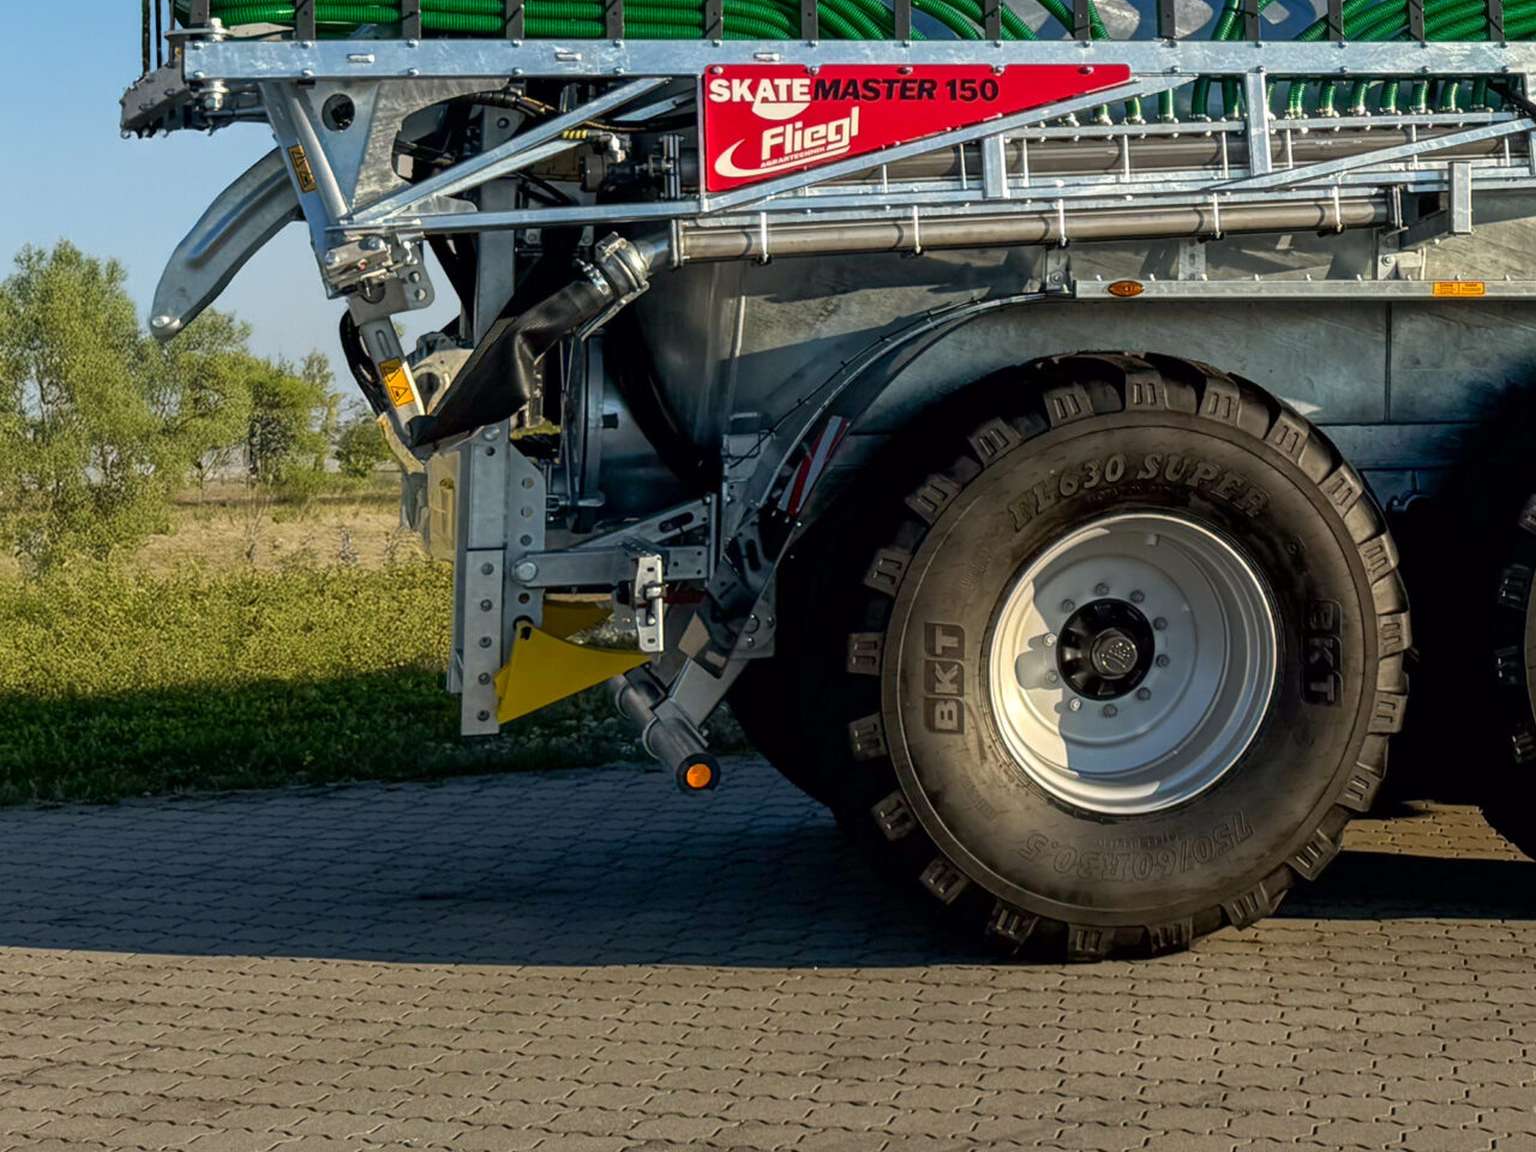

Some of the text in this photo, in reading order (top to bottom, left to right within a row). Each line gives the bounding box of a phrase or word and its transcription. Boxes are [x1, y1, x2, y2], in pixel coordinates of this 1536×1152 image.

[945, 77, 1000, 102] 150
[760, 105, 860, 161] Fliegl
[1136, 452, 1272, 518] SUPER
[924, 622, 965, 734] BKT
